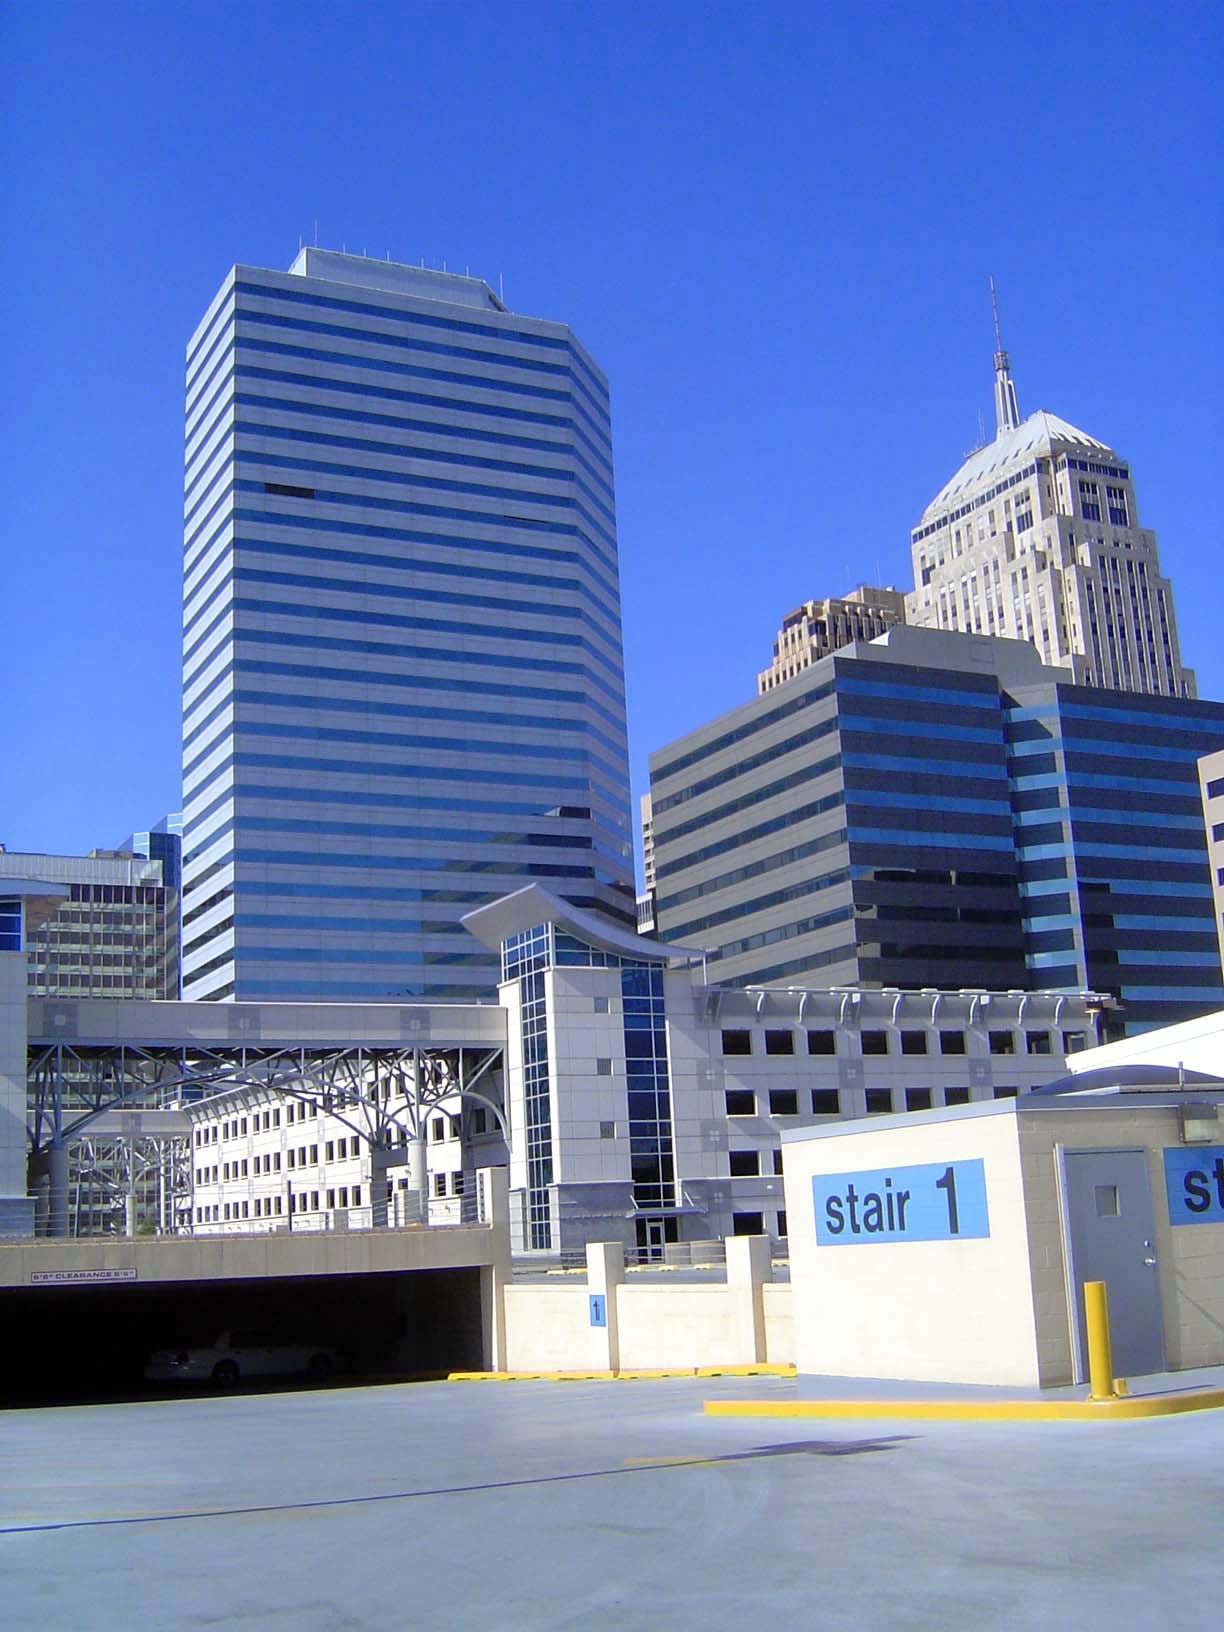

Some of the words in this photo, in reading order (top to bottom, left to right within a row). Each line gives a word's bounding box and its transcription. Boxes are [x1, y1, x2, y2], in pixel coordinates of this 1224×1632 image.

[825, 1177, 911, 1235] stair
[935, 1166, 959, 1234] 1
[55, 1271, 111, 1280] CLEARANCE
